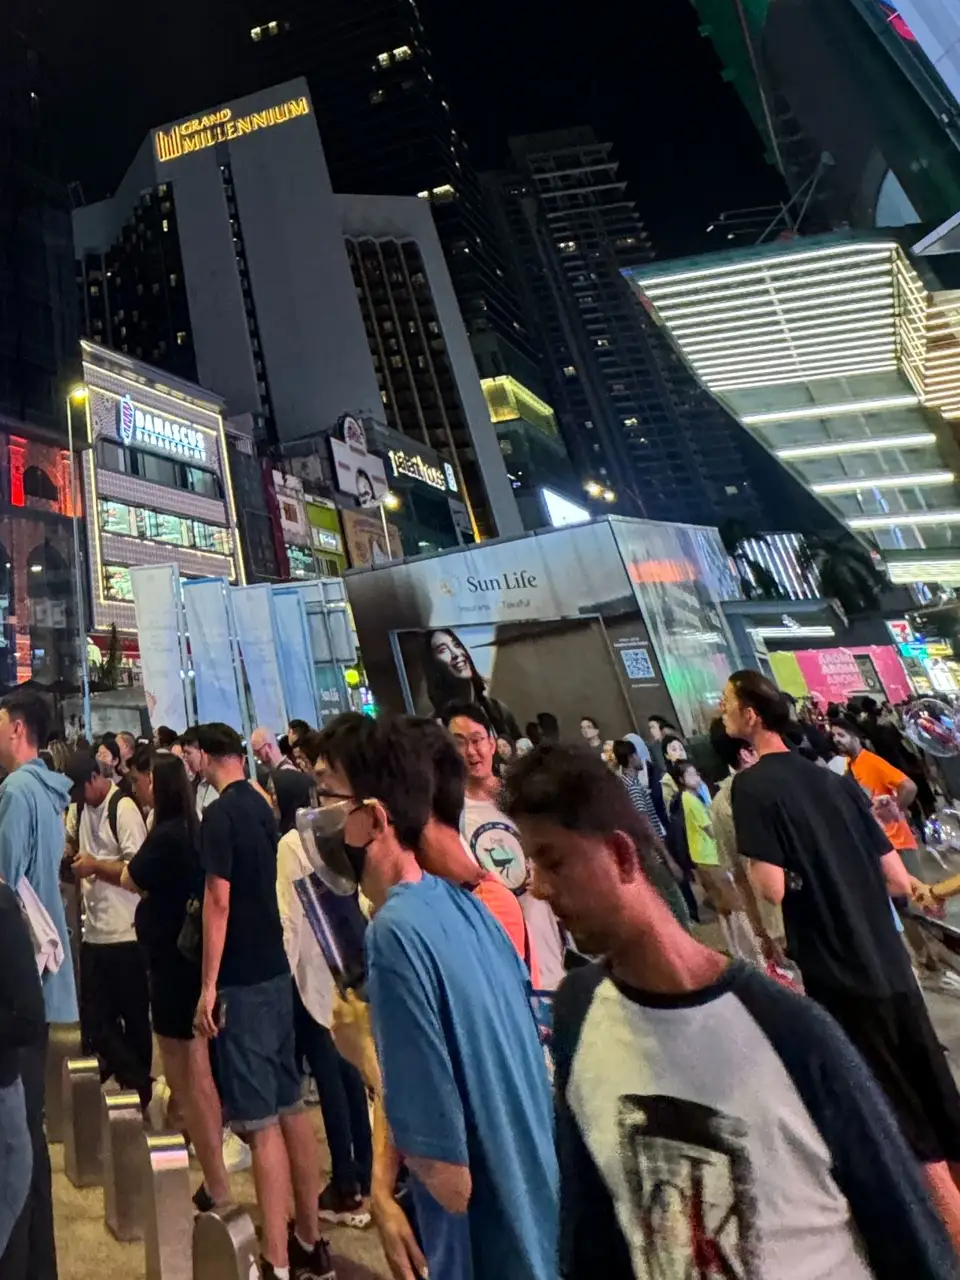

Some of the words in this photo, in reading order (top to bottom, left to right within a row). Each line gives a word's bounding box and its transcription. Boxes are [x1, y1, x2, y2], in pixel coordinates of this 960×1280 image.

[181, 108, 232, 135] GRAND
[182, 96, 310, 154] MILLENNIUM
[135, 409, 205, 449] DAMASCUS
[466, 575, 501, 593] Sun
[502, 569, 538, 590] Life
